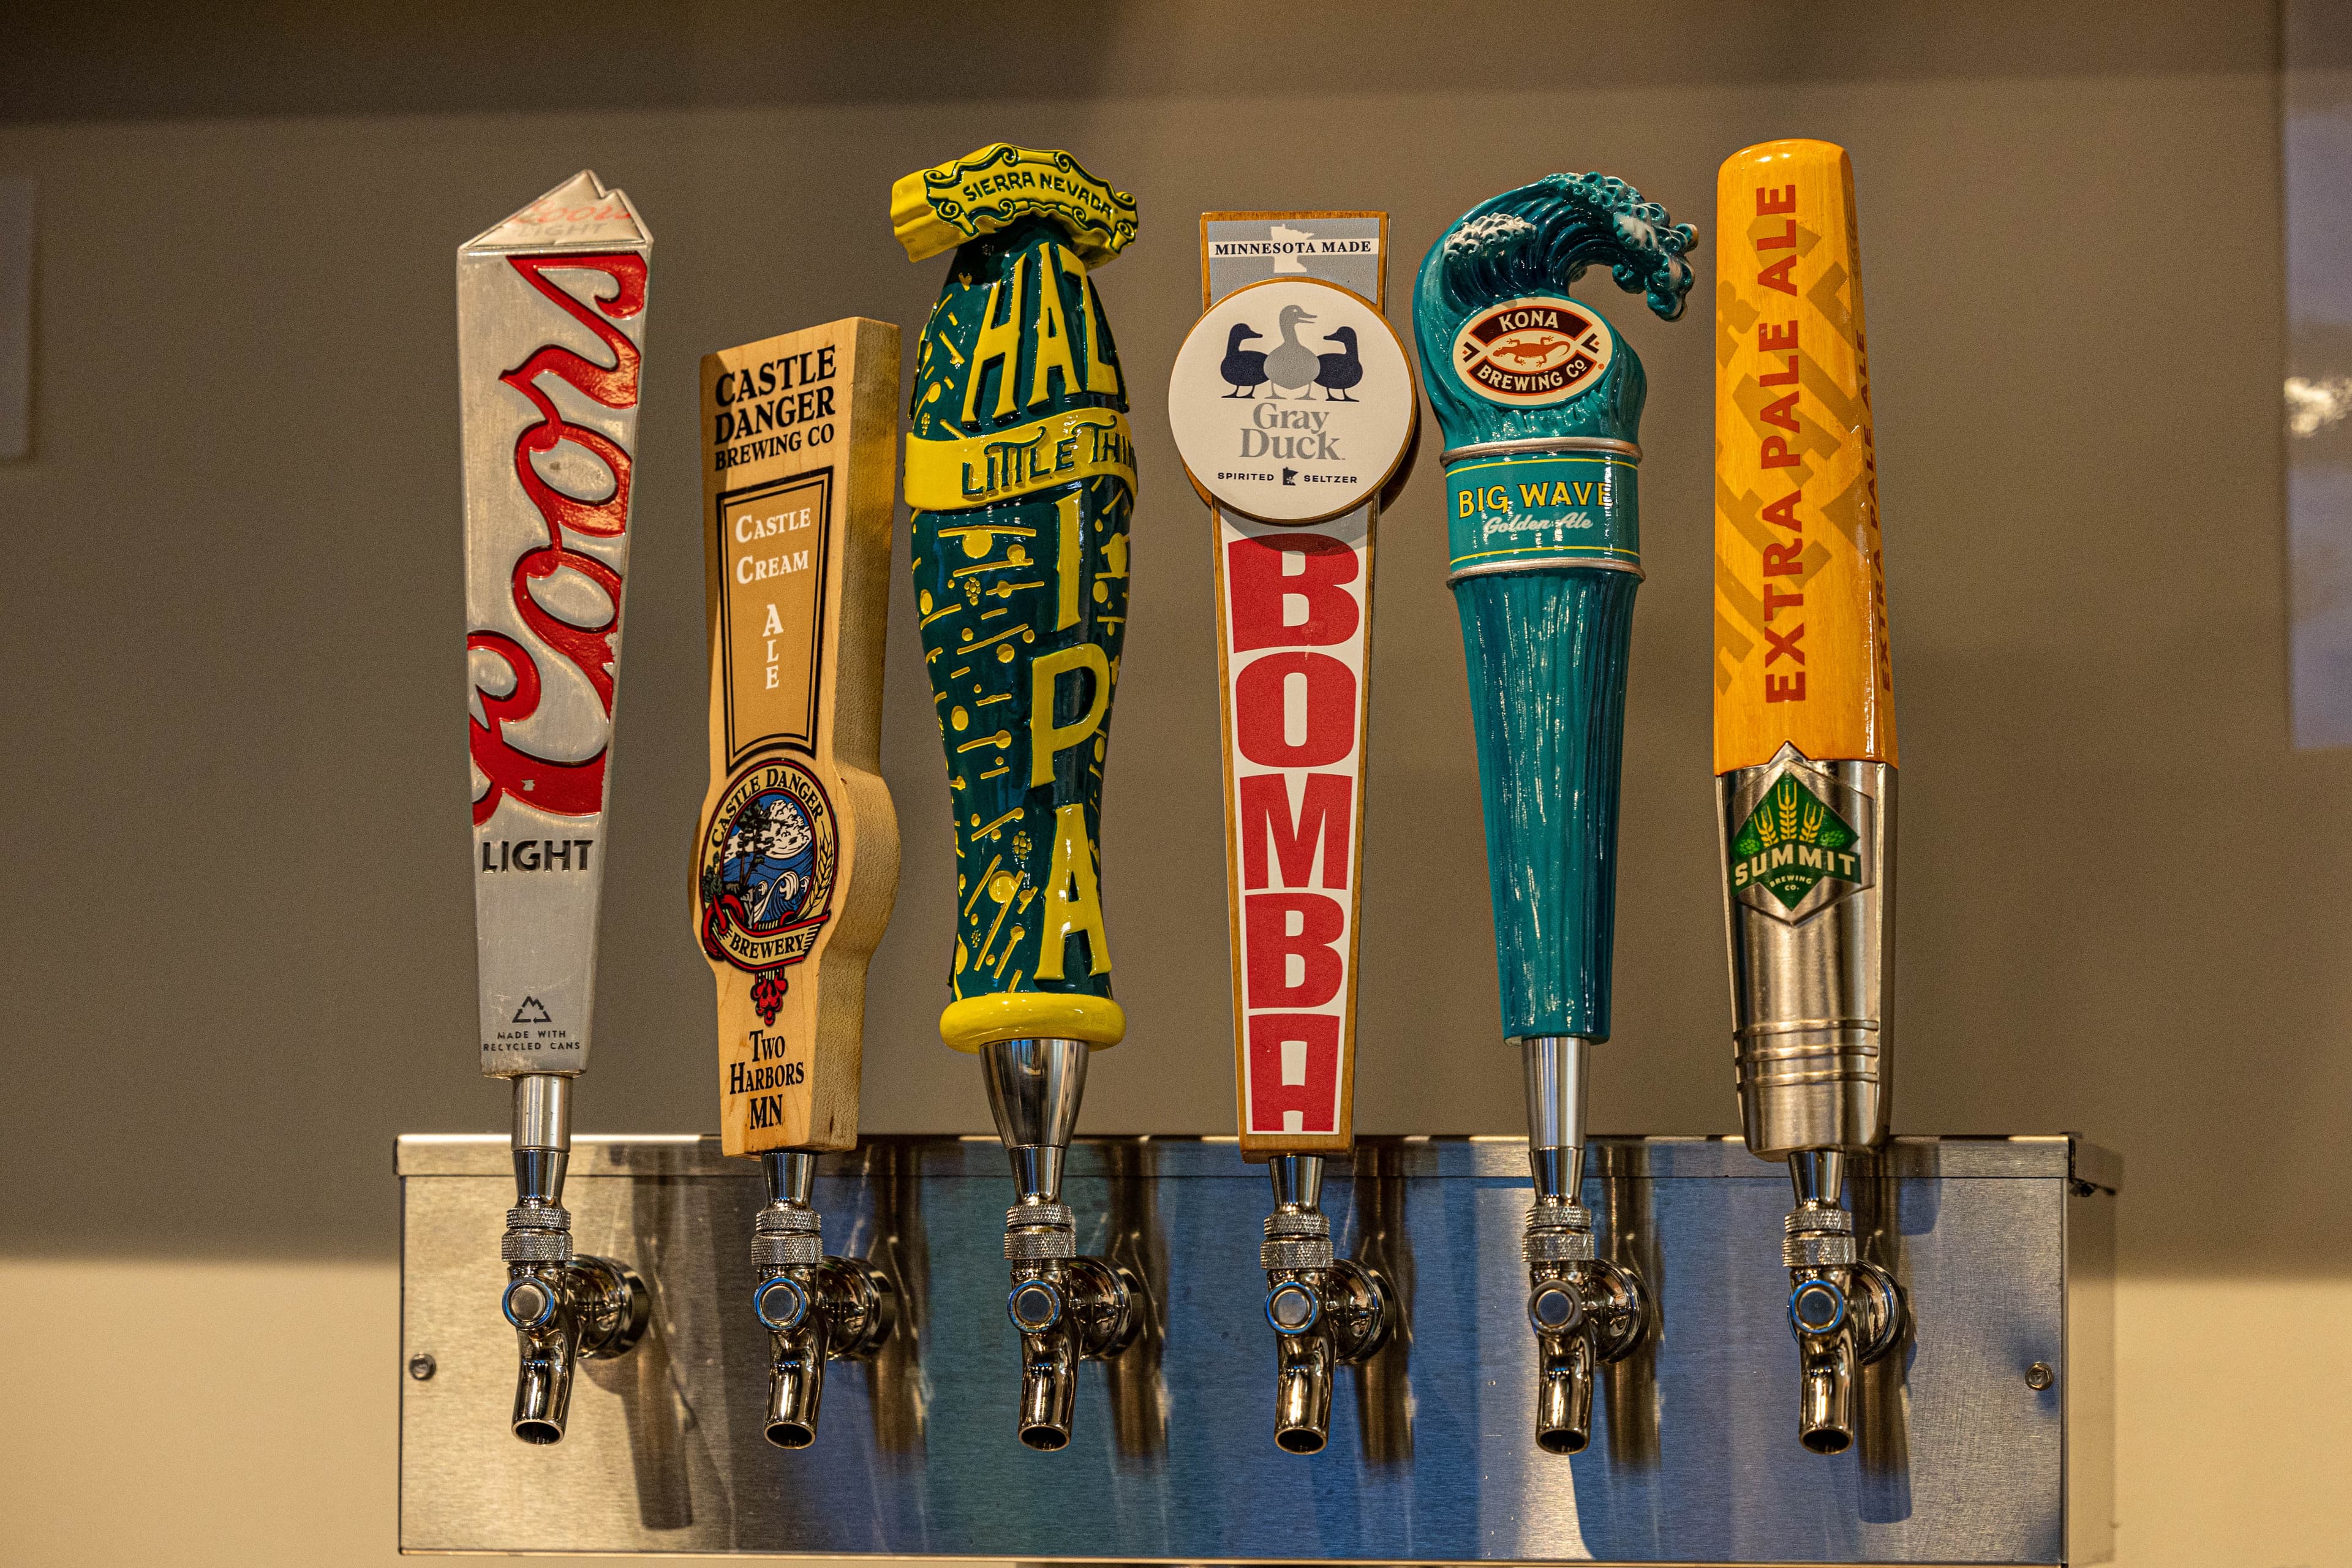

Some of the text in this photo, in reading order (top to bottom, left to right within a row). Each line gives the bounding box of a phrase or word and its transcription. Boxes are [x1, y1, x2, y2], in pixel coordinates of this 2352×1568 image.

[962, 171, 1114, 219] SIERRA NEVADA
[1215, 241, 1371, 255] MINNESOTA MADE
[1498, 310, 1559, 332] KONA
[715, 344, 837, 407] CASTLE
[1477, 364, 1563, 391] BREWING
[715, 386, 835, 445] DANGER
[1253, 402, 1329, 435] Gray
[715, 423, 834, 472] BREWING CO
[962, 426, 1076, 496] LITTLE
[1238, 428, 1343, 461] Duck
[1756, 184, 1806, 703] EXTRA PALE ALE
[1217, 472, 1357, 484] SPIRITED SELTZER
[1458, 481, 1614, 519] BIG WAVE
[1855, 329, 1891, 693] EXTRA PALE ALE
[461, 251, 647, 827] Coors
[735, 508, 811, 544] CASTLE
[1482, 511, 1594, 535] Golden Ale
[736, 550, 809, 584] CREAM
[763, 603, 784, 690] ALE
[1031, 489, 1112, 980] IPA
[712, 768, 824, 848] CASTLE DANGER
[1228, 533, 1360, 1132] BOMBA
[482, 839, 594, 873] LIGHT
[1735, 843, 1855, 886] SUMMIT
[1769, 875, 1813, 888] BREWING
[729, 933, 805, 959] BREWERY
[483, 1041, 581, 1052] RECYCLED CANS
[497, 1030, 567, 1040] MADE WITH
[749, 1029, 785, 1063] TWO
[729, 1061, 804, 1095] HARBORS
[749, 1094, 783, 1130] MN
